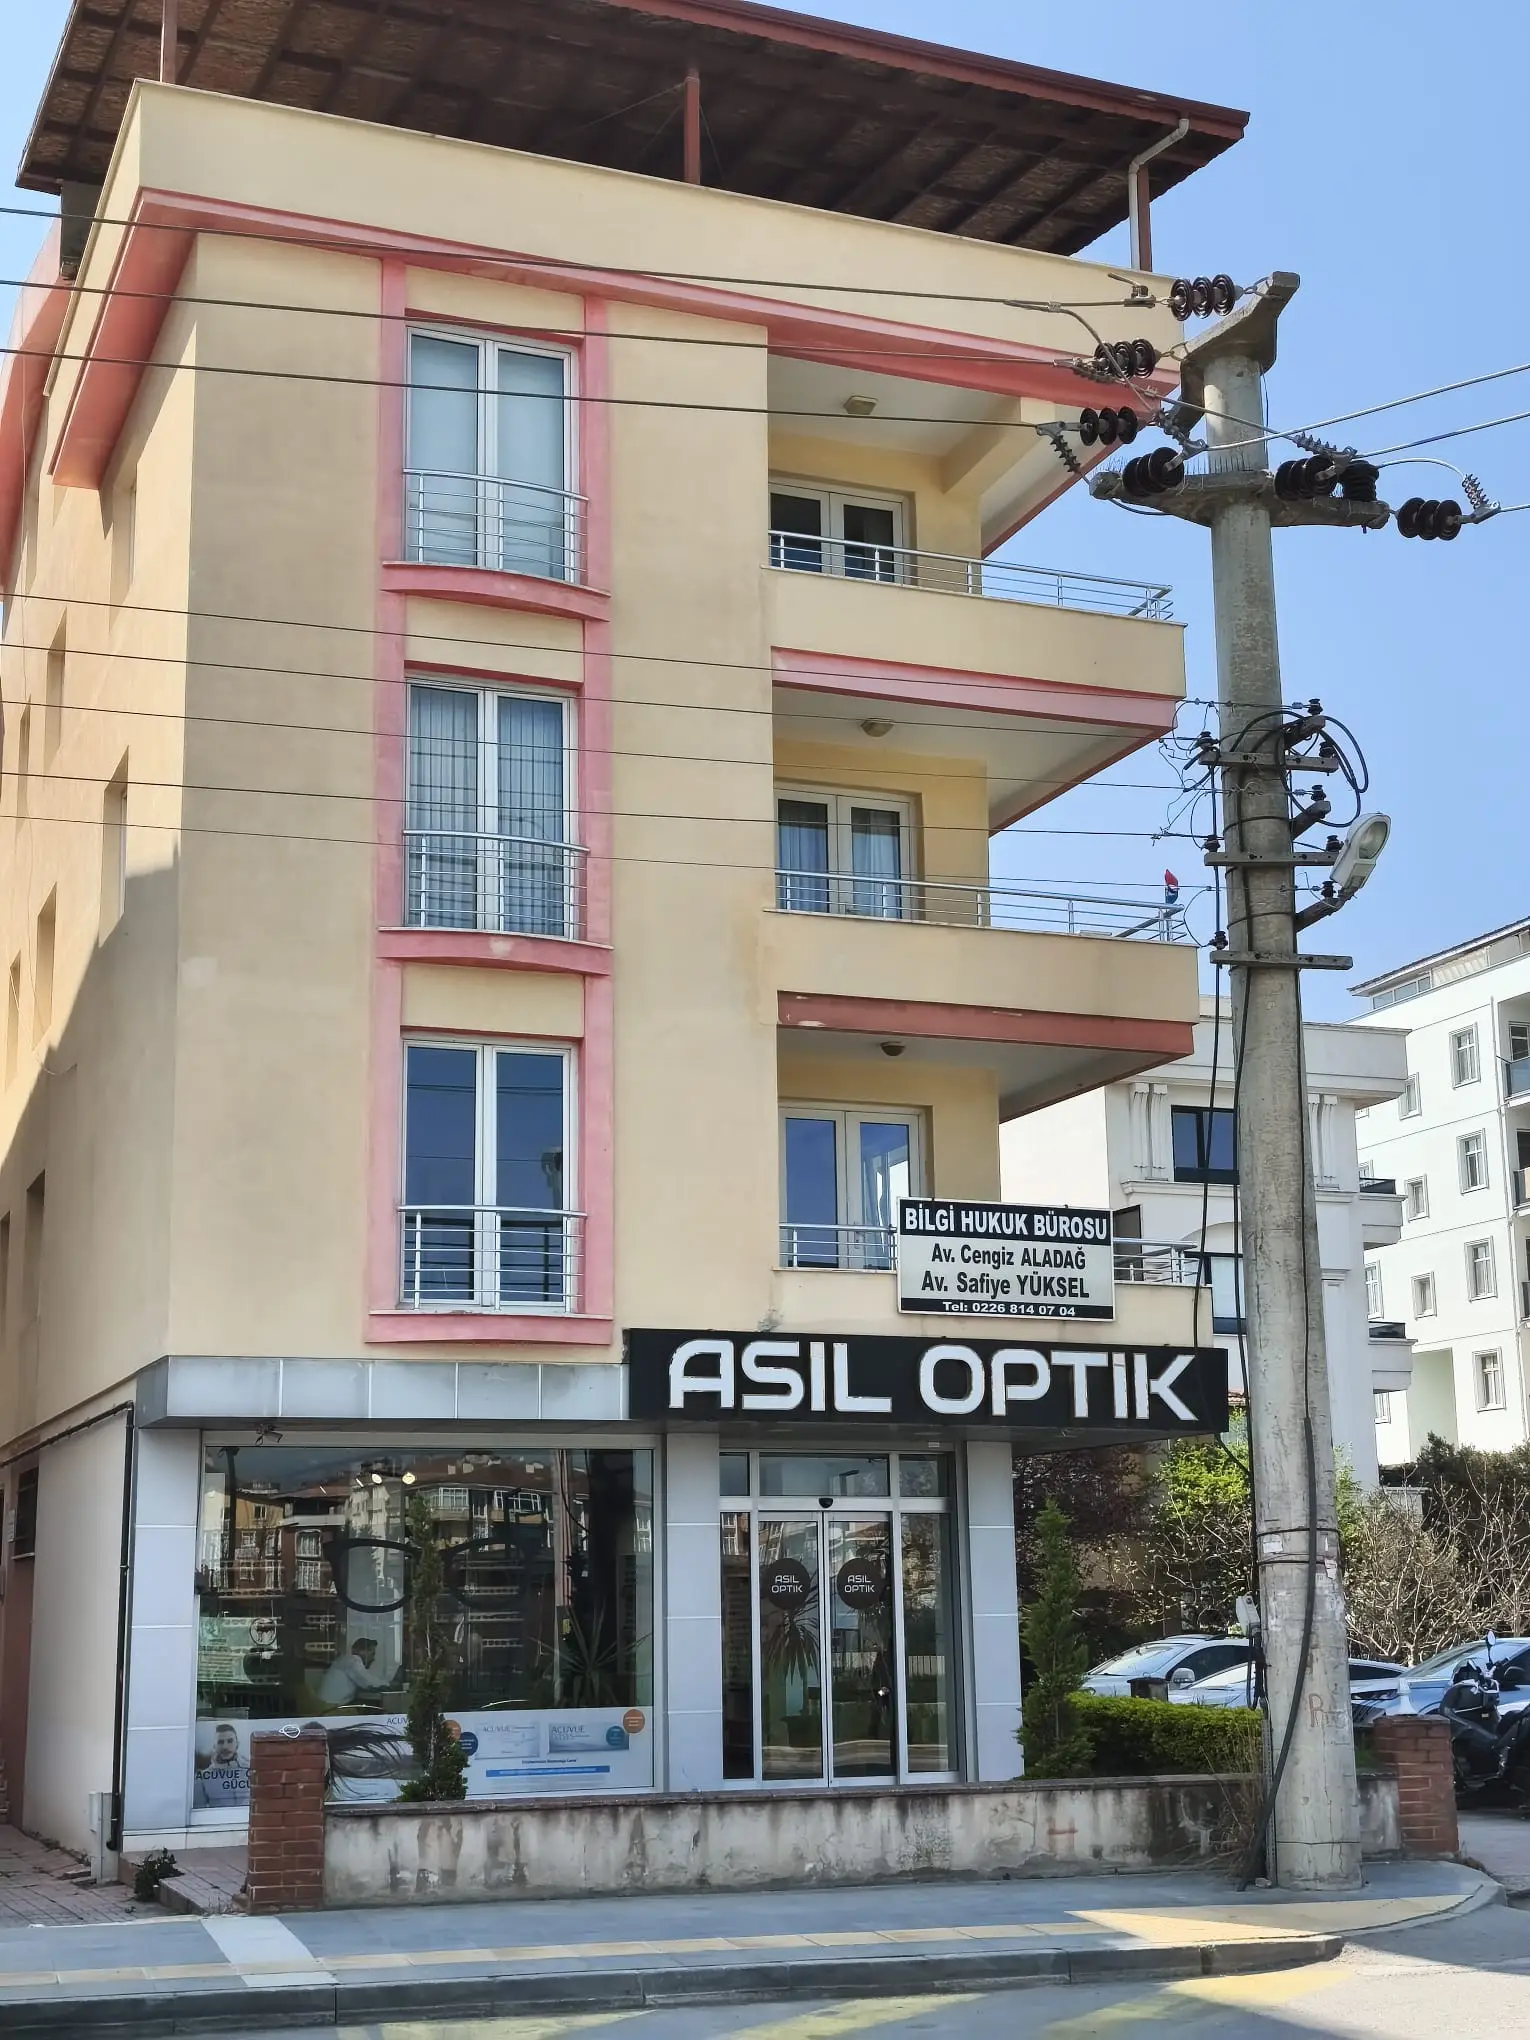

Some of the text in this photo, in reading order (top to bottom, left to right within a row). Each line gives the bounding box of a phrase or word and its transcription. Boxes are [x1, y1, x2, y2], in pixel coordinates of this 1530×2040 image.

[905, 1203, 1107, 1240] BİLGİ HUKUK BÜROSU
[931, 1243, 1086, 1270] Av. Cengiz ALADAĞ
[921, 1270, 1089, 1300] Av. Safiye YÜKSEL
[943, 1301, 1076, 1317] Tel: 0226 814 07 04
[195, 1768, 240, 1780] ACUVUE
